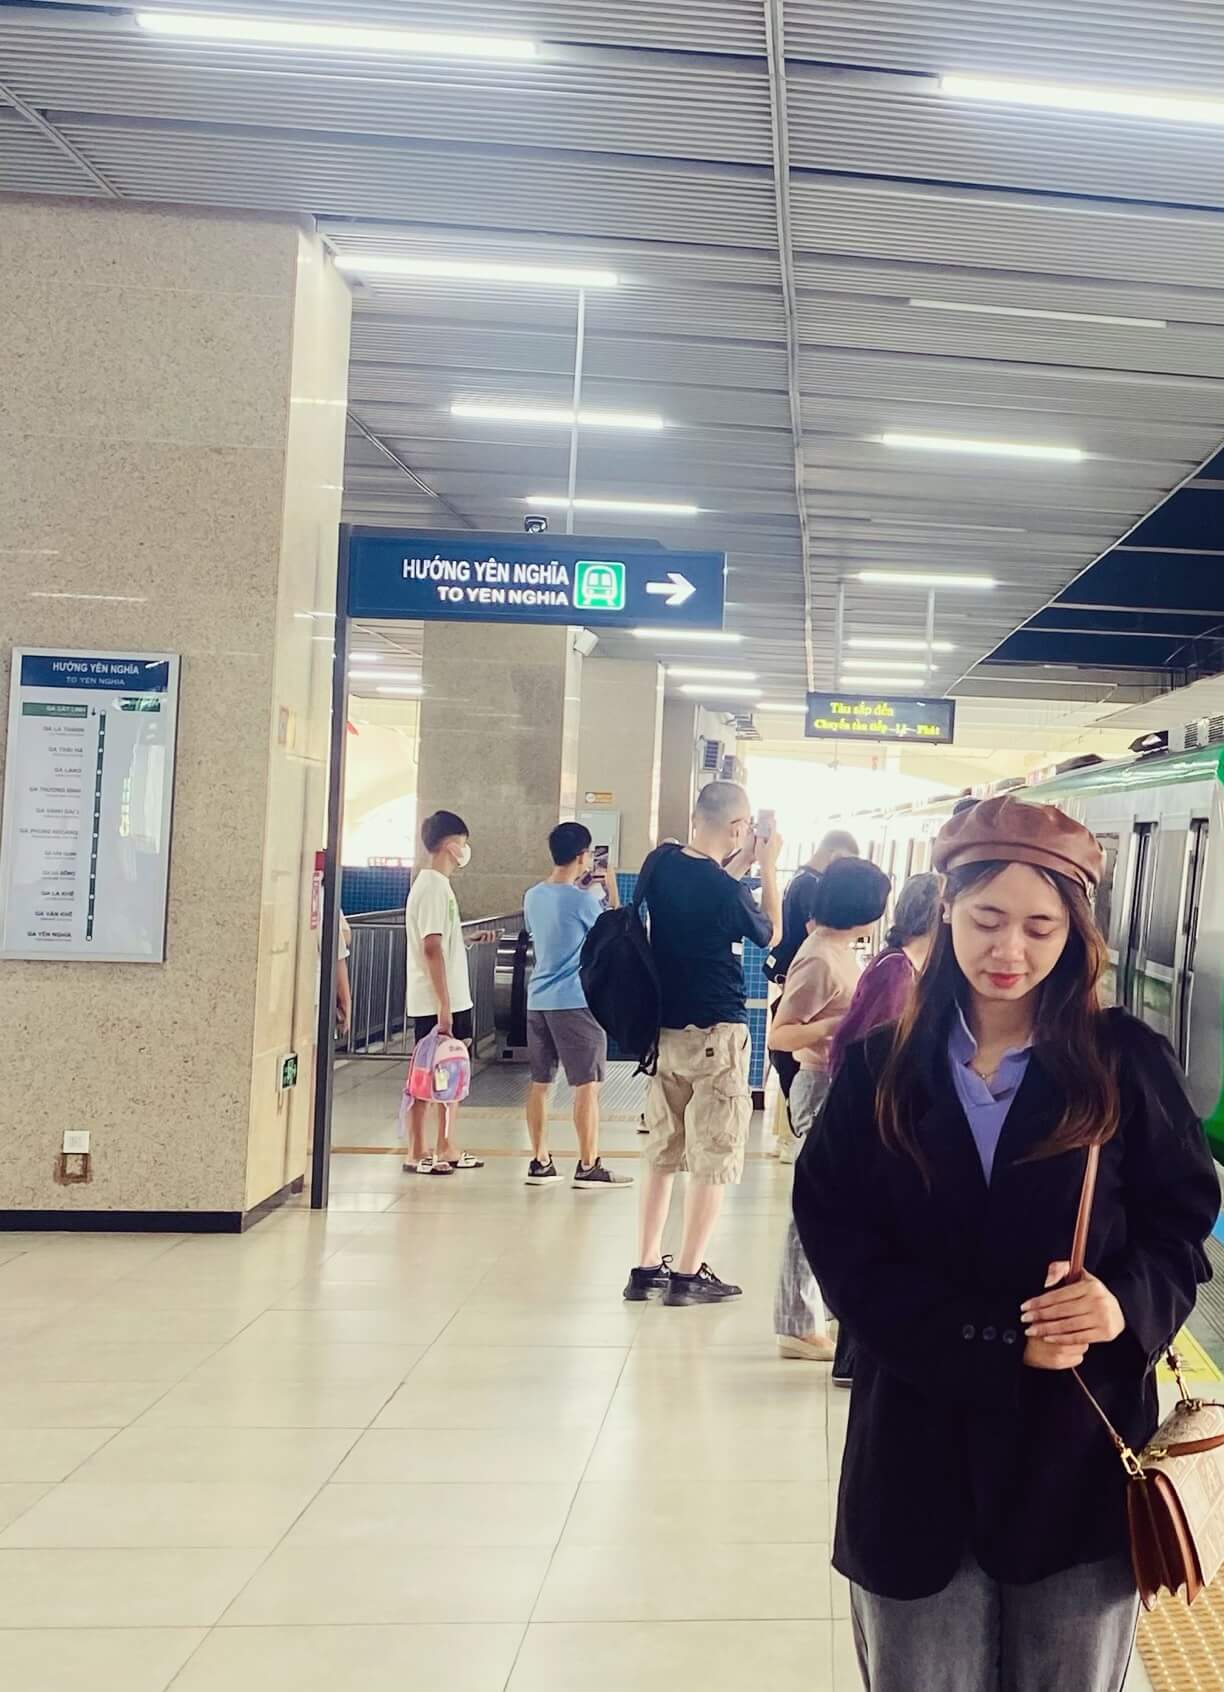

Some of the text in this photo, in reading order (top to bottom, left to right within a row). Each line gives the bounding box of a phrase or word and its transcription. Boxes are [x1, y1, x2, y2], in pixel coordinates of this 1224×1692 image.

[403, 555, 569, 585] HƯỚNG YÊN NGHĨA
[437, 586, 568, 606] TO YEN NGHIA
[52, 660, 139, 675] HƯỚNG YÊN NGHĨA
[66, 676, 126, 686] TO YEN NGHIA
